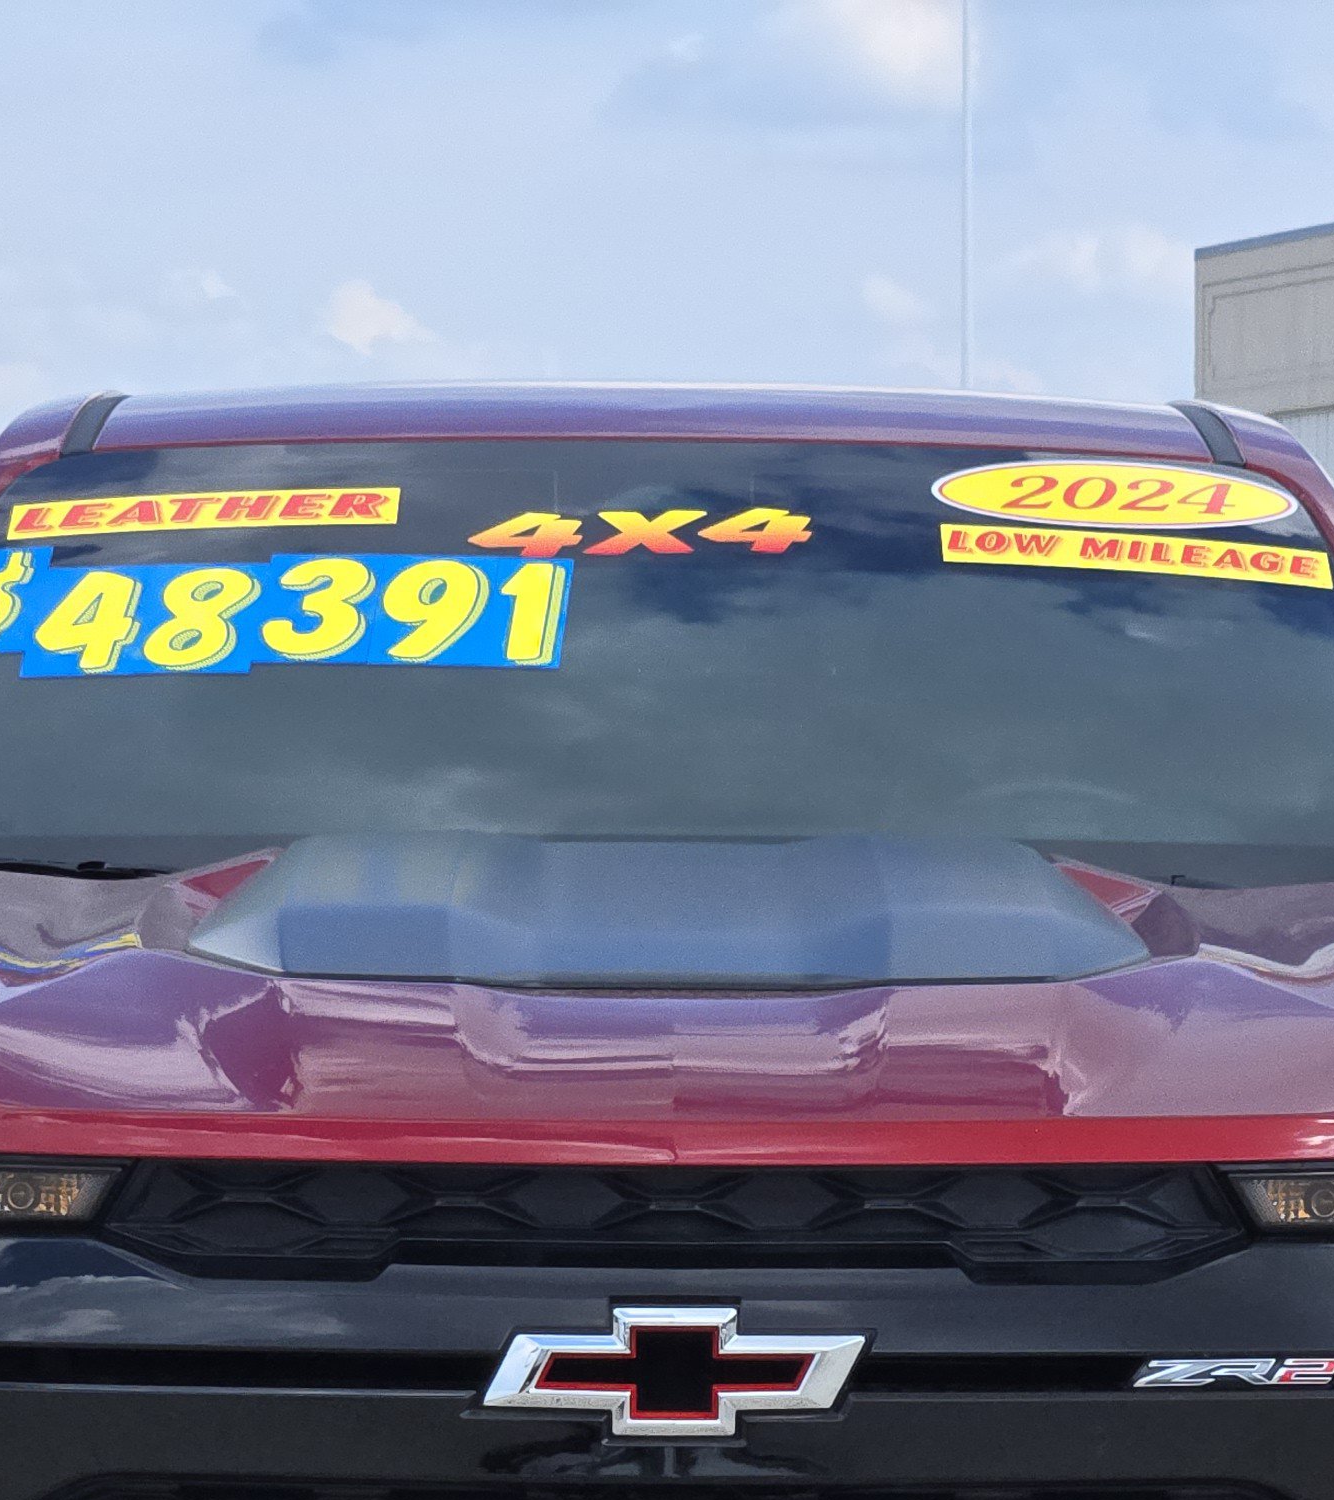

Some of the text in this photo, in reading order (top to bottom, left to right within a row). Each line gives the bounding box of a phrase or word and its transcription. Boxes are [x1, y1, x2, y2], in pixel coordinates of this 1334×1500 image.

[14, 492, 391, 534] LEATHER
[1001, 475, 1235, 515] 2024
[947, 529, 1319, 578] LOW MILEAGE
